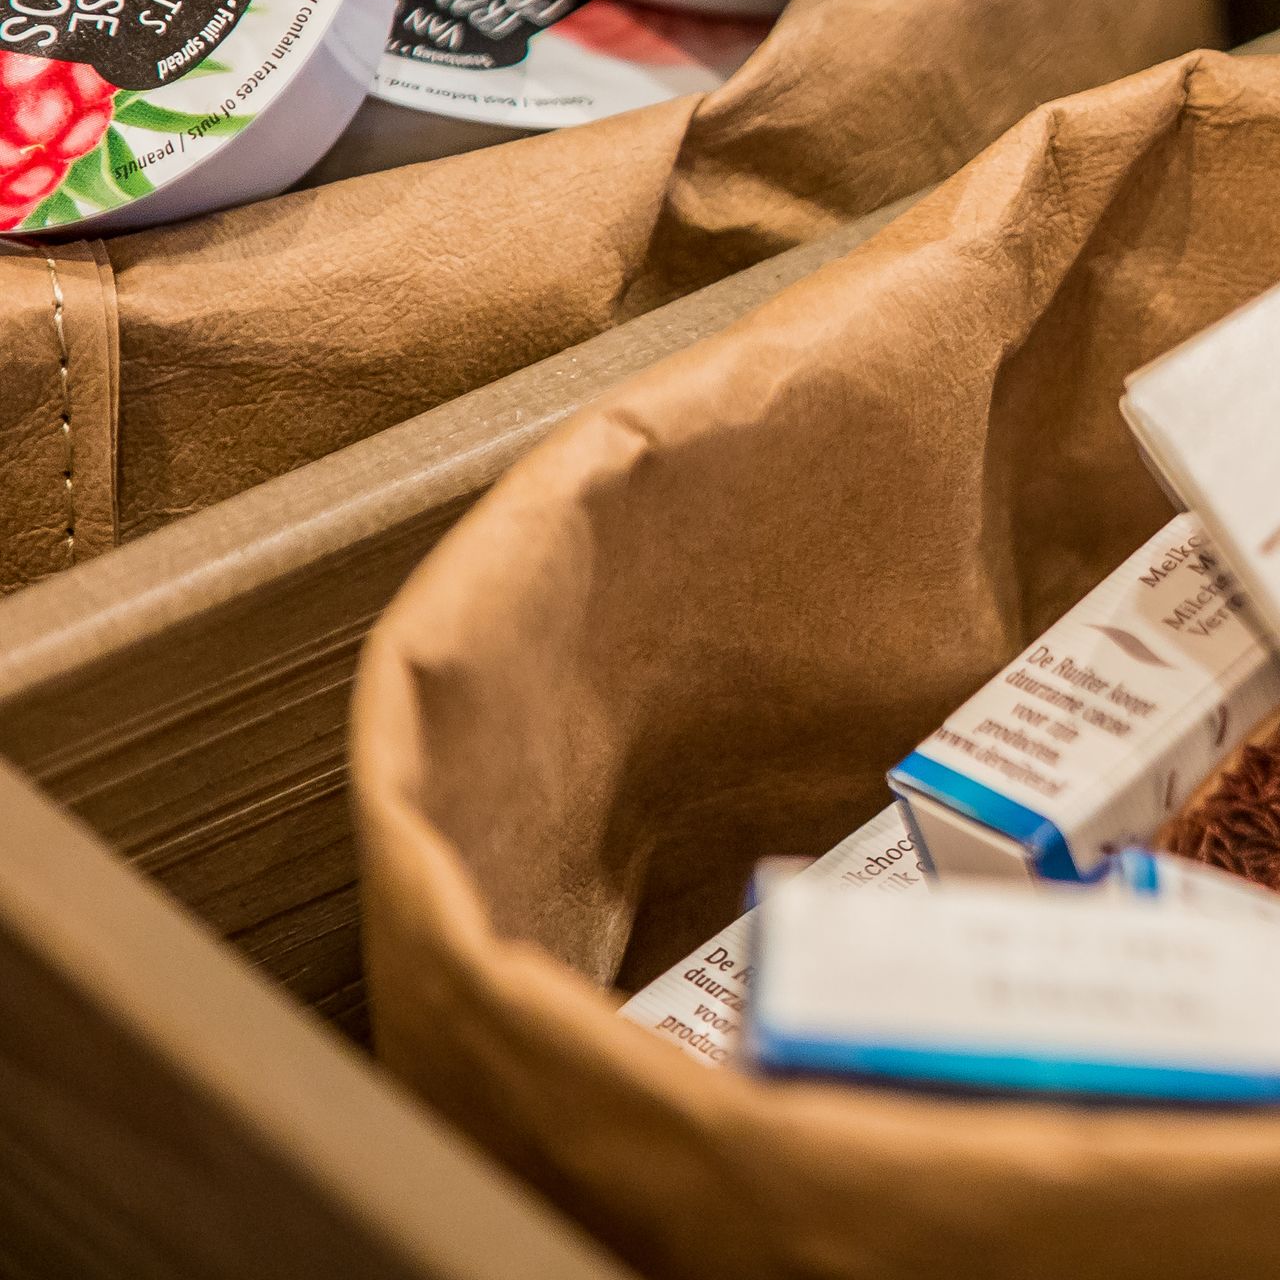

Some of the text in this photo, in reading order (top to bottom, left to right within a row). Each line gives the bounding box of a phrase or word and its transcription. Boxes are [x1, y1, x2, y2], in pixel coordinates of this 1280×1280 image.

[199, 7, 235, 45] Fruit
[271, 7, 312, 60] contain
[156, 39, 207, 80] spread
[236, 60, 278, 100] traces
[187, 113, 221, 140] nuts
[220, 99, 236, 120] of
[114, 140, 175, 180] peanuts
[704, 946, 735, 972] De
